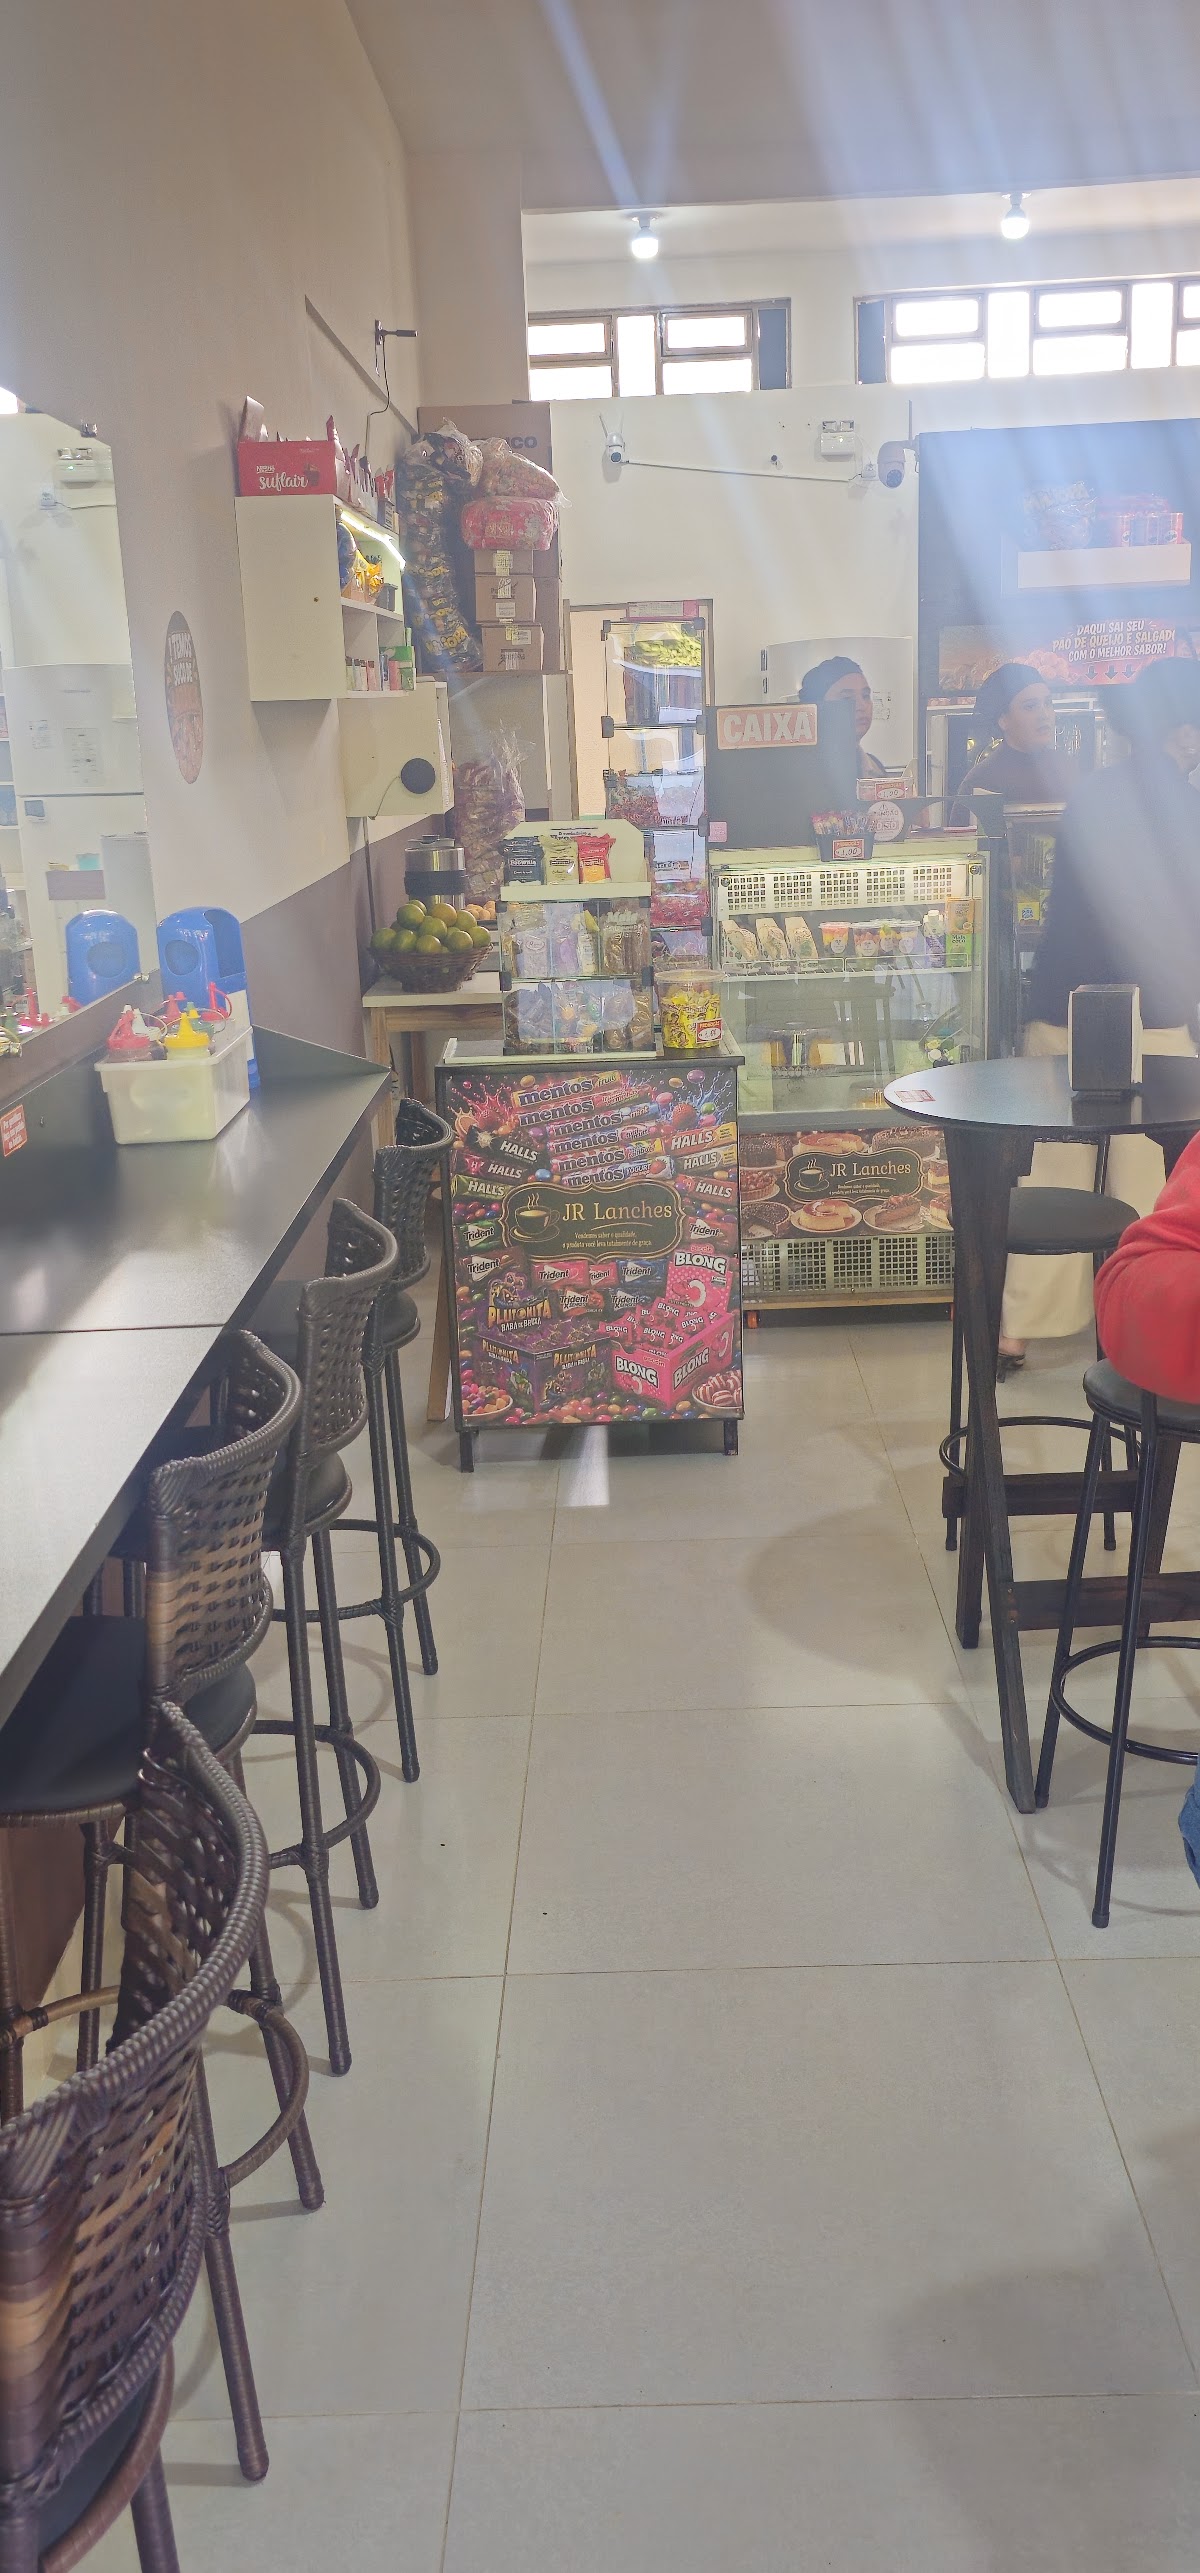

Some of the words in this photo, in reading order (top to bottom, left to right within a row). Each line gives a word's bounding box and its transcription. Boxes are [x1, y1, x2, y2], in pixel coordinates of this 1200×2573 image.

[259, 471, 309, 492] suflair
[1077, 623, 1106, 636] DAQUI
[1108, 622, 1124, 632] SAI
[1127, 620, 1144, 632] SEU
[1074, 637, 1087, 649] DE
[1089, 633, 1123, 648] QUEIJO
[1126, 632, 1132, 644] E
[1068, 650, 1087, 662] COM
[1090, 649, 1096, 659] O
[1098, 645, 1131, 658] MELHOR
[1134, 643, 1166, 656] SABOR!
[723, 712, 813, 743] CAIXA
[519, 1080, 593, 1106] mentos
[519, 1101, 594, 1126] mentos
[553, 1112, 622, 1137] mentos
[630, 1106, 649, 1118] mint
[553, 1131, 619, 1154] mentos
[671, 1130, 713, 1150] HALLS
[500, 1140, 538, 1161] HALLS
[558, 1150, 625, 1172] mentos
[683, 1152, 717, 1169] HALLS
[830, 1163, 847, 1177] JR
[853, 1161, 911, 1176] Lanches
[488, 1163, 522, 1179] HALLS
[568, 1169, 624, 1187] mentos
[467, 1180, 505, 1196] HALLS
[696, 1182, 732, 1198] HALLS
[562, 1203, 585, 1221] JR
[593, 1200, 672, 1220] Lanches
[463, 1226, 494, 1241] Trident
[689, 1224, 720, 1236] Trident
[467, 1258, 500, 1273] Trident
[622, 1266, 652, 1276] Trident
[675, 1252, 727, 1275] BLONG
[539, 1269, 570, 1280] Trident
[560, 1294, 589, 1304] Trident
[611, 1294, 639, 1304] Trident
[487, 1298, 552, 1328] PLUTONITA
[657, 1302, 679, 1316] BLONG
[606, 1325, 628, 1334] BLONG
[682, 1316, 704, 1328] BLONG
[643, 1327, 665, 1339] BLONG
[616, 1356, 658, 1389] BLONG
[673, 1347, 709, 1390] BLONG
